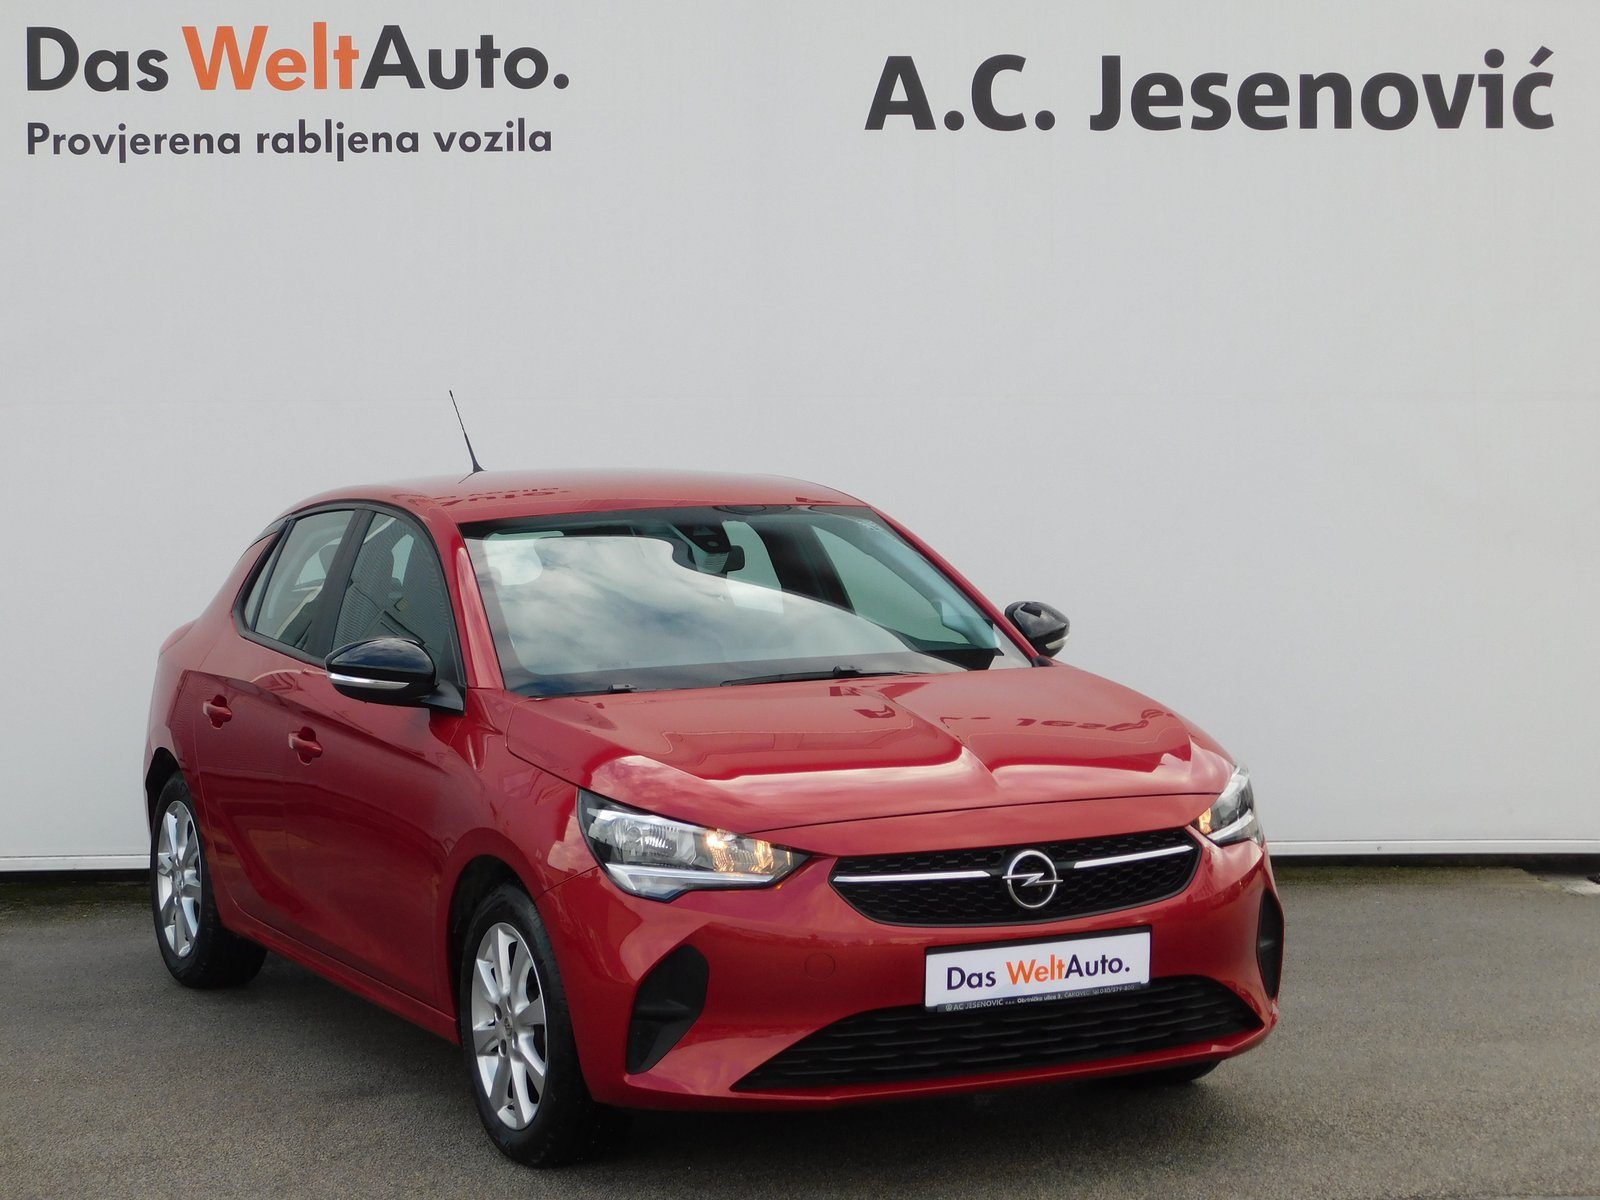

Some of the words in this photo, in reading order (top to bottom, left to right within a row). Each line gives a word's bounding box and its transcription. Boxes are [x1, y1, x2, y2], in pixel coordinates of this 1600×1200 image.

[27, 27, 168, 92] Das
[182, 22, 569, 91] WeltAuto.
[865, 54, 1055, 131] A.C.
[1090, 46, 1554, 131] Jesenović
[28, 122, 240, 163] Provjerena
[257, 119, 418, 161] rabljena
[434, 118, 551, 152] vozila
[946, 966, 997, 990] Das
[1006, 953, 1131, 985] WeltAuto.
